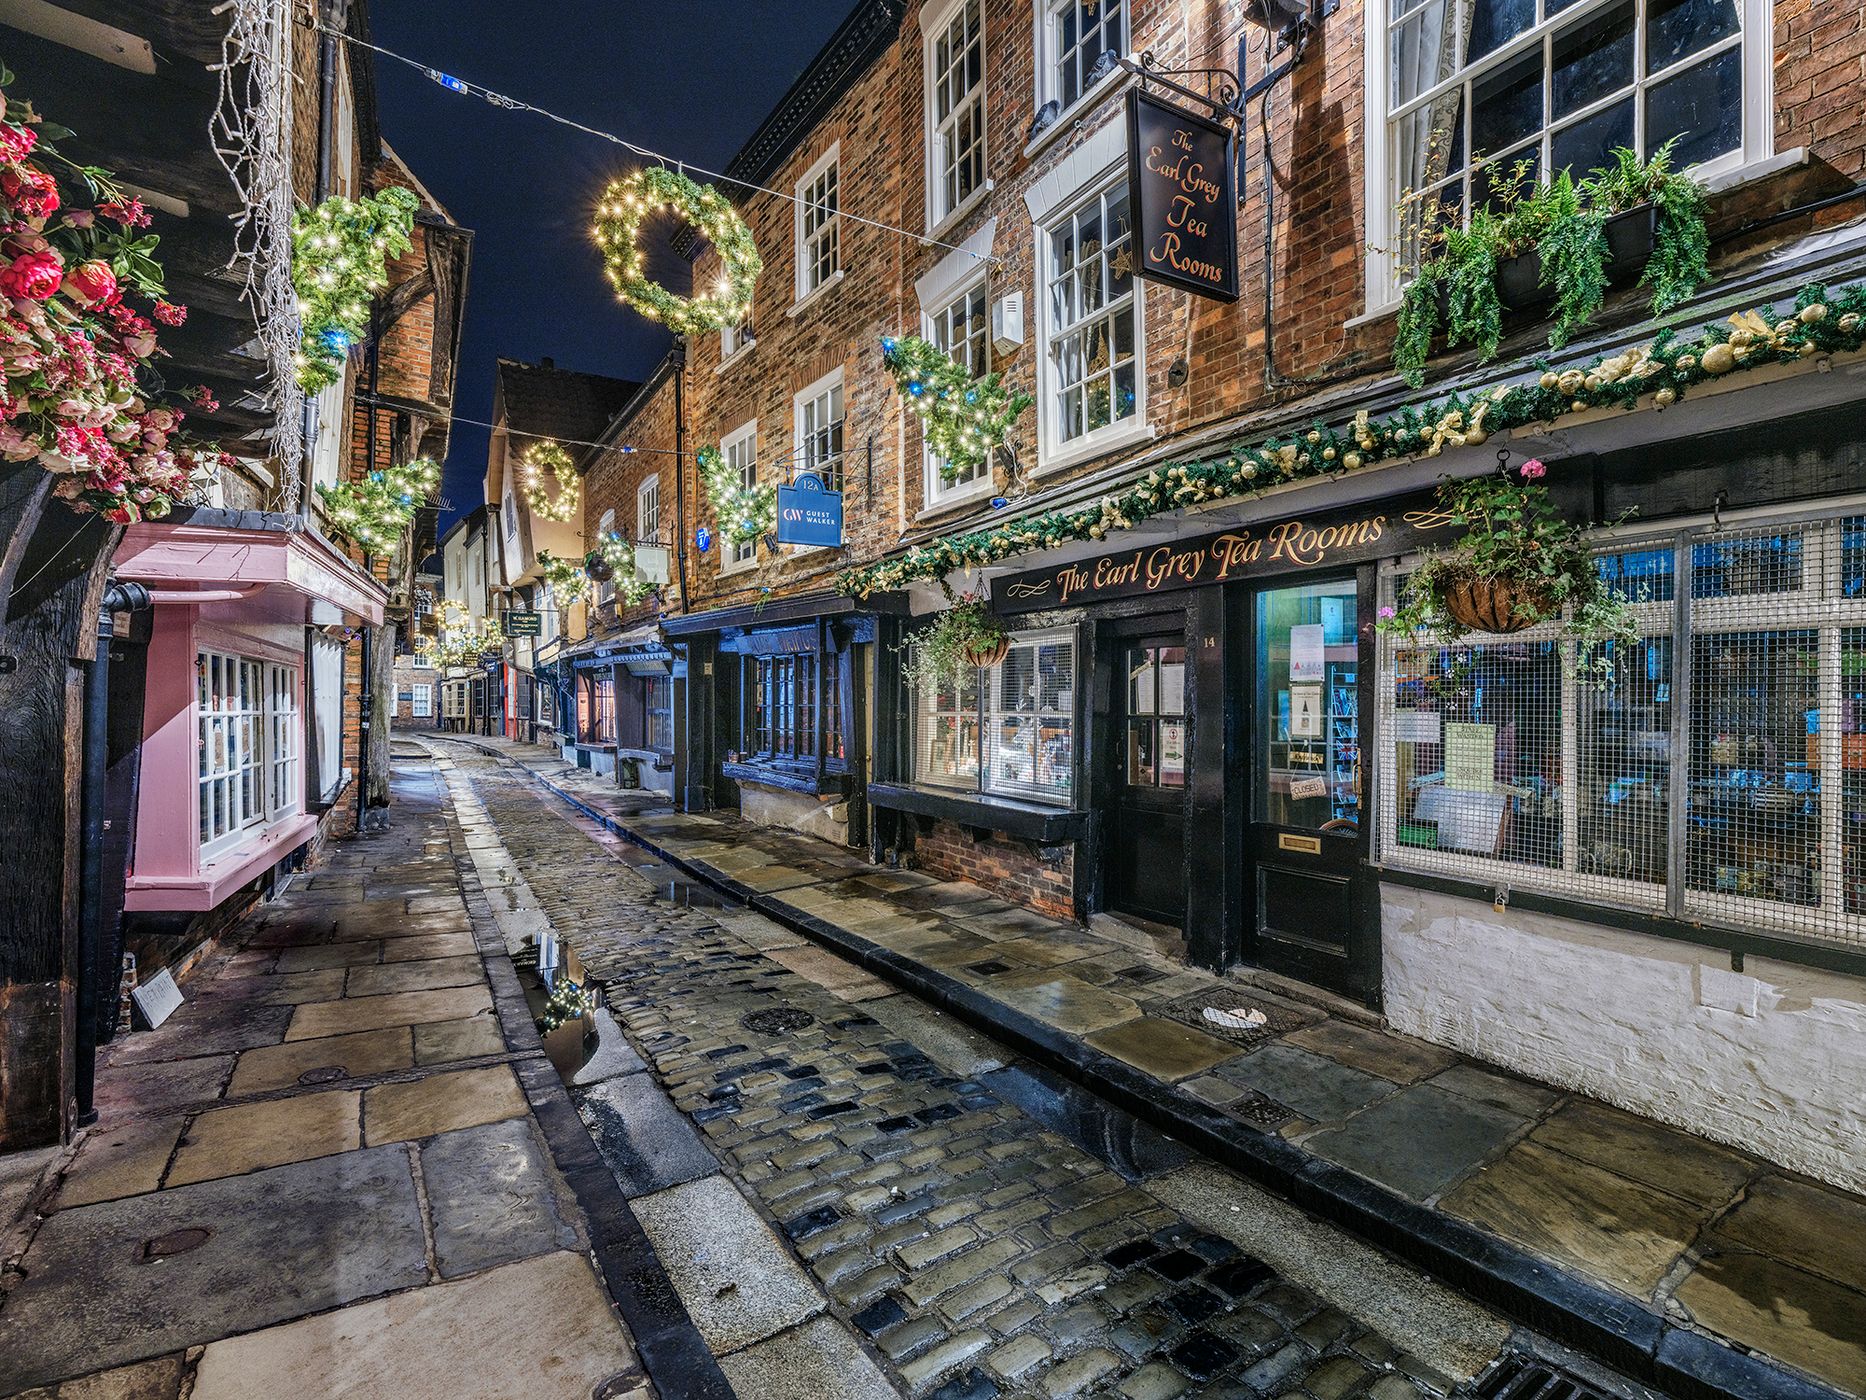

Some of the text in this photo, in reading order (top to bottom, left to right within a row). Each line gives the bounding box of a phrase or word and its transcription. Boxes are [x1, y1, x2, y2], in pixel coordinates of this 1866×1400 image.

[1171, 128, 1193, 152] The
[1145, 146, 1221, 203] Earl Grey
[1166, 194, 1208, 238] Tea
[1149, 232, 1223, 283] Rooms
[803, 480, 819, 491] 12A
[806, 510, 830, 518] GUEST
[806, 517, 835, 525] WALKER
[1057, 515, 1387, 603] The Earl Grey Tea Rooms
[1204, 637, 1215, 648] 14
[1293, 783, 1319, 795] CLOSED
